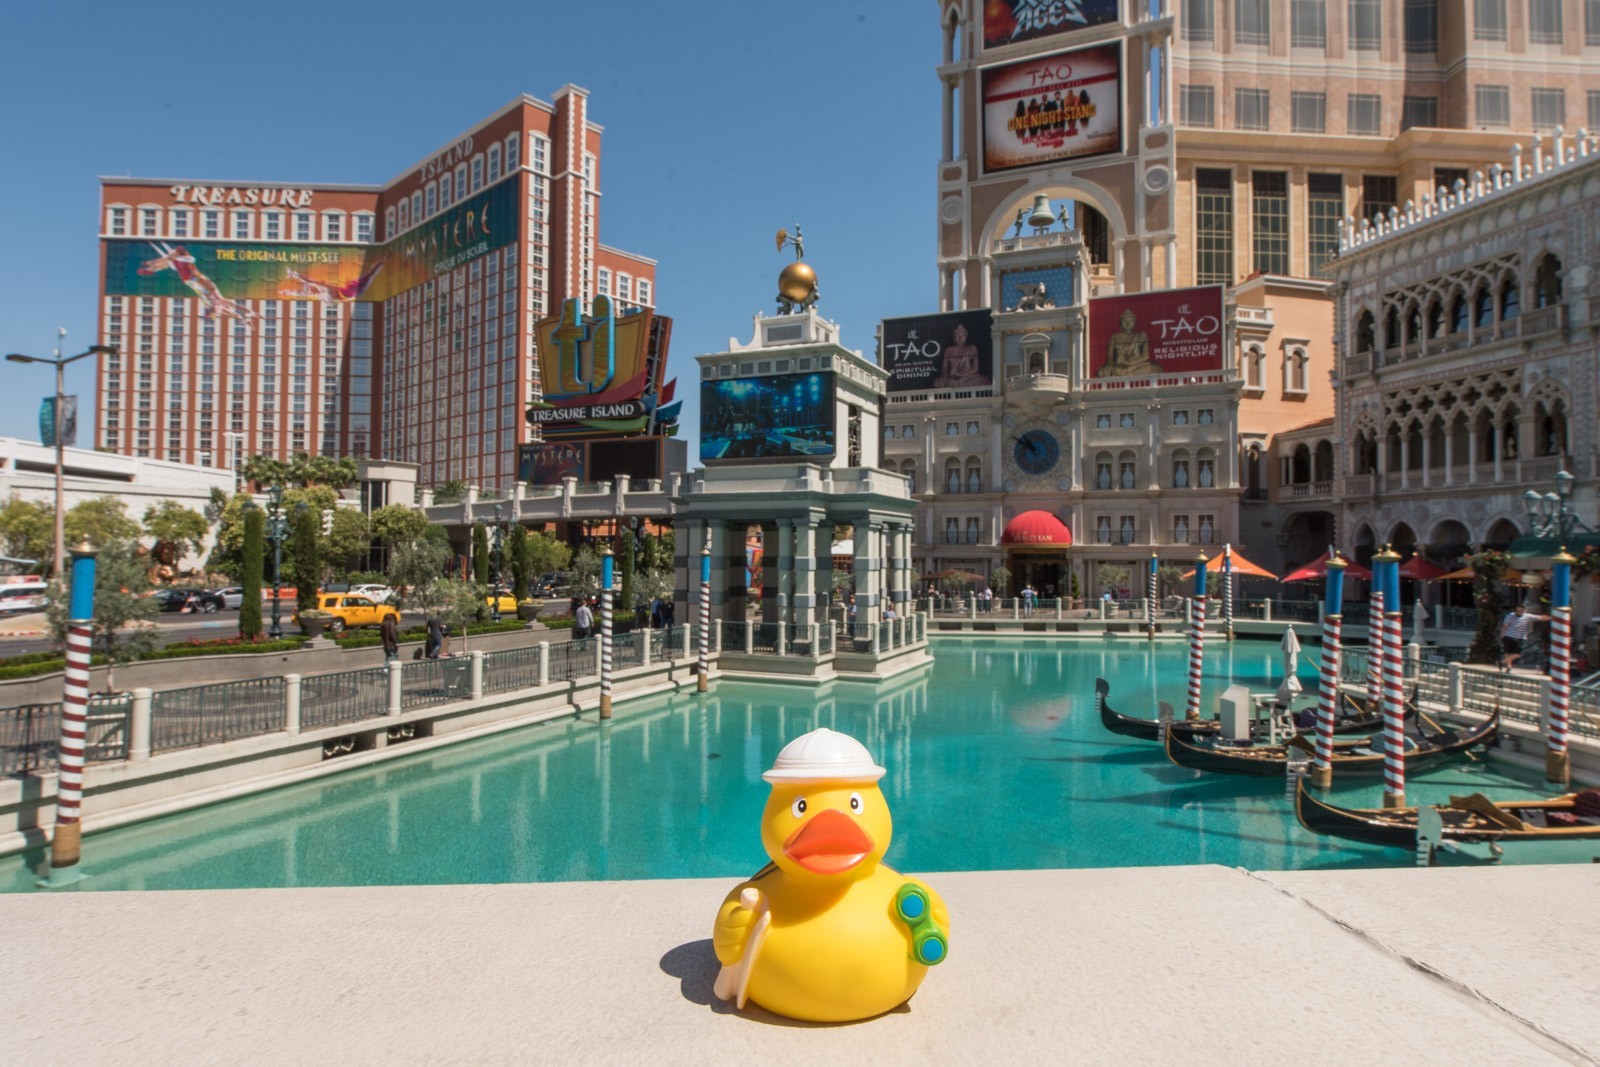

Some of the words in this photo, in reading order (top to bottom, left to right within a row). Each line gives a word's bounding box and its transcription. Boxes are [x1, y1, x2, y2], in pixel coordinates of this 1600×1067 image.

[1025, 64, 1072, 86] TAO
[1007, 114, 1030, 131] ONE
[1030, 109, 1062, 127] NIGHT
[1063, 103, 1097, 121] STAND
[419, 136, 474, 184] ISLAND
[171, 185, 314, 209] TREASURE
[216, 249, 237, 261] THE
[238, 250, 287, 262] ORIGINAL
[290, 251, 340, 264] MUST-SEE
[466, 241, 489, 259] SOLEIL
[1151, 315, 1220, 339] TAO
[886, 340, 941, 361] TAO
[1154, 344, 1217, 354] RELIGIOUS
[1155, 350, 1216, 359] NIGHTLIFE
[890, 365, 938, 375] SPIRITUAL
[896, 371, 931, 380] DINING
[532, 406, 587, 422] TREASURE
[591, 403, 635, 418] ISLAND
